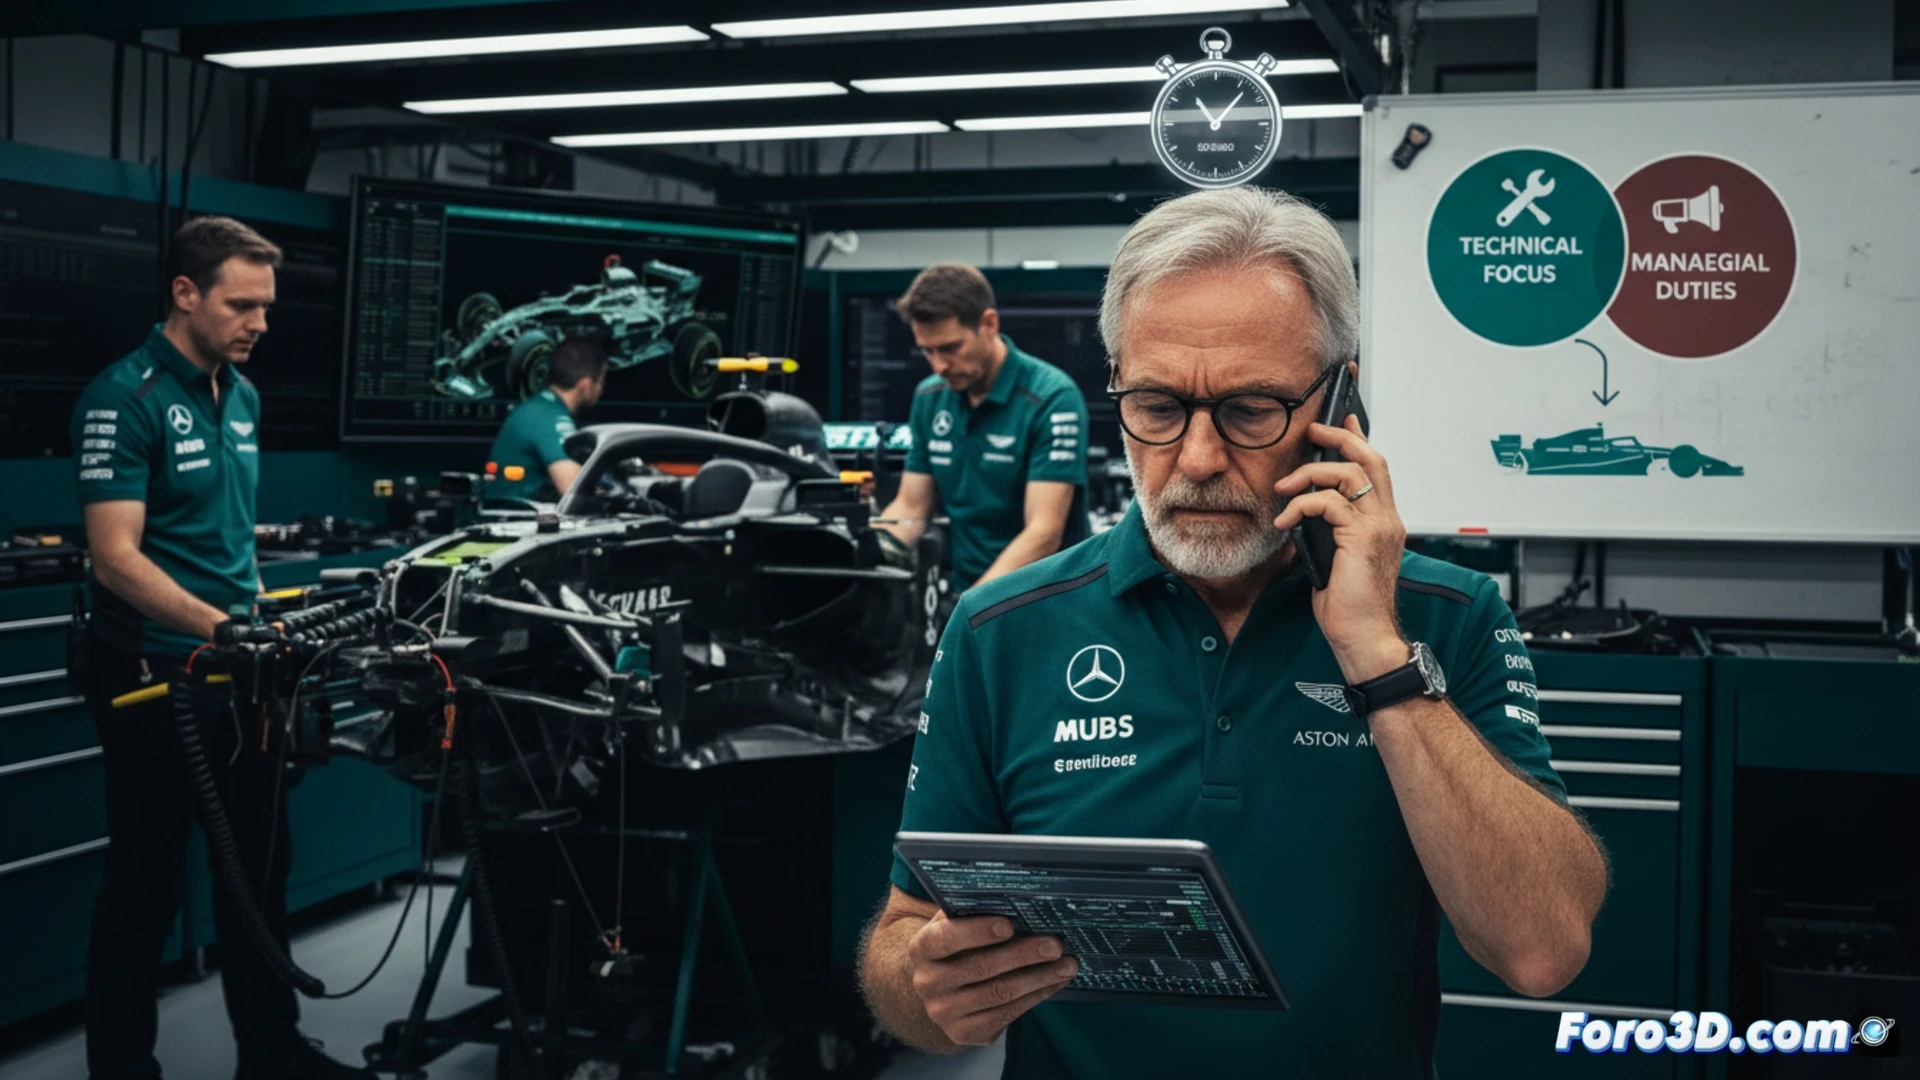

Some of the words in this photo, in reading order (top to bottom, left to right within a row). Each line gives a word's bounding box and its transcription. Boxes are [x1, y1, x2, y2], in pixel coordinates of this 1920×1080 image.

[1459, 236, 1583, 256] TECHNICAL
[1631, 252, 1771, 273] MANAEGIAL
[1483, 264, 1557, 284] FOCUS
[1656, 281, 1737, 300] DUTIES
[1053, 714, 1134, 743] MUBS
[1293, 730, 1350, 747] ASTON
